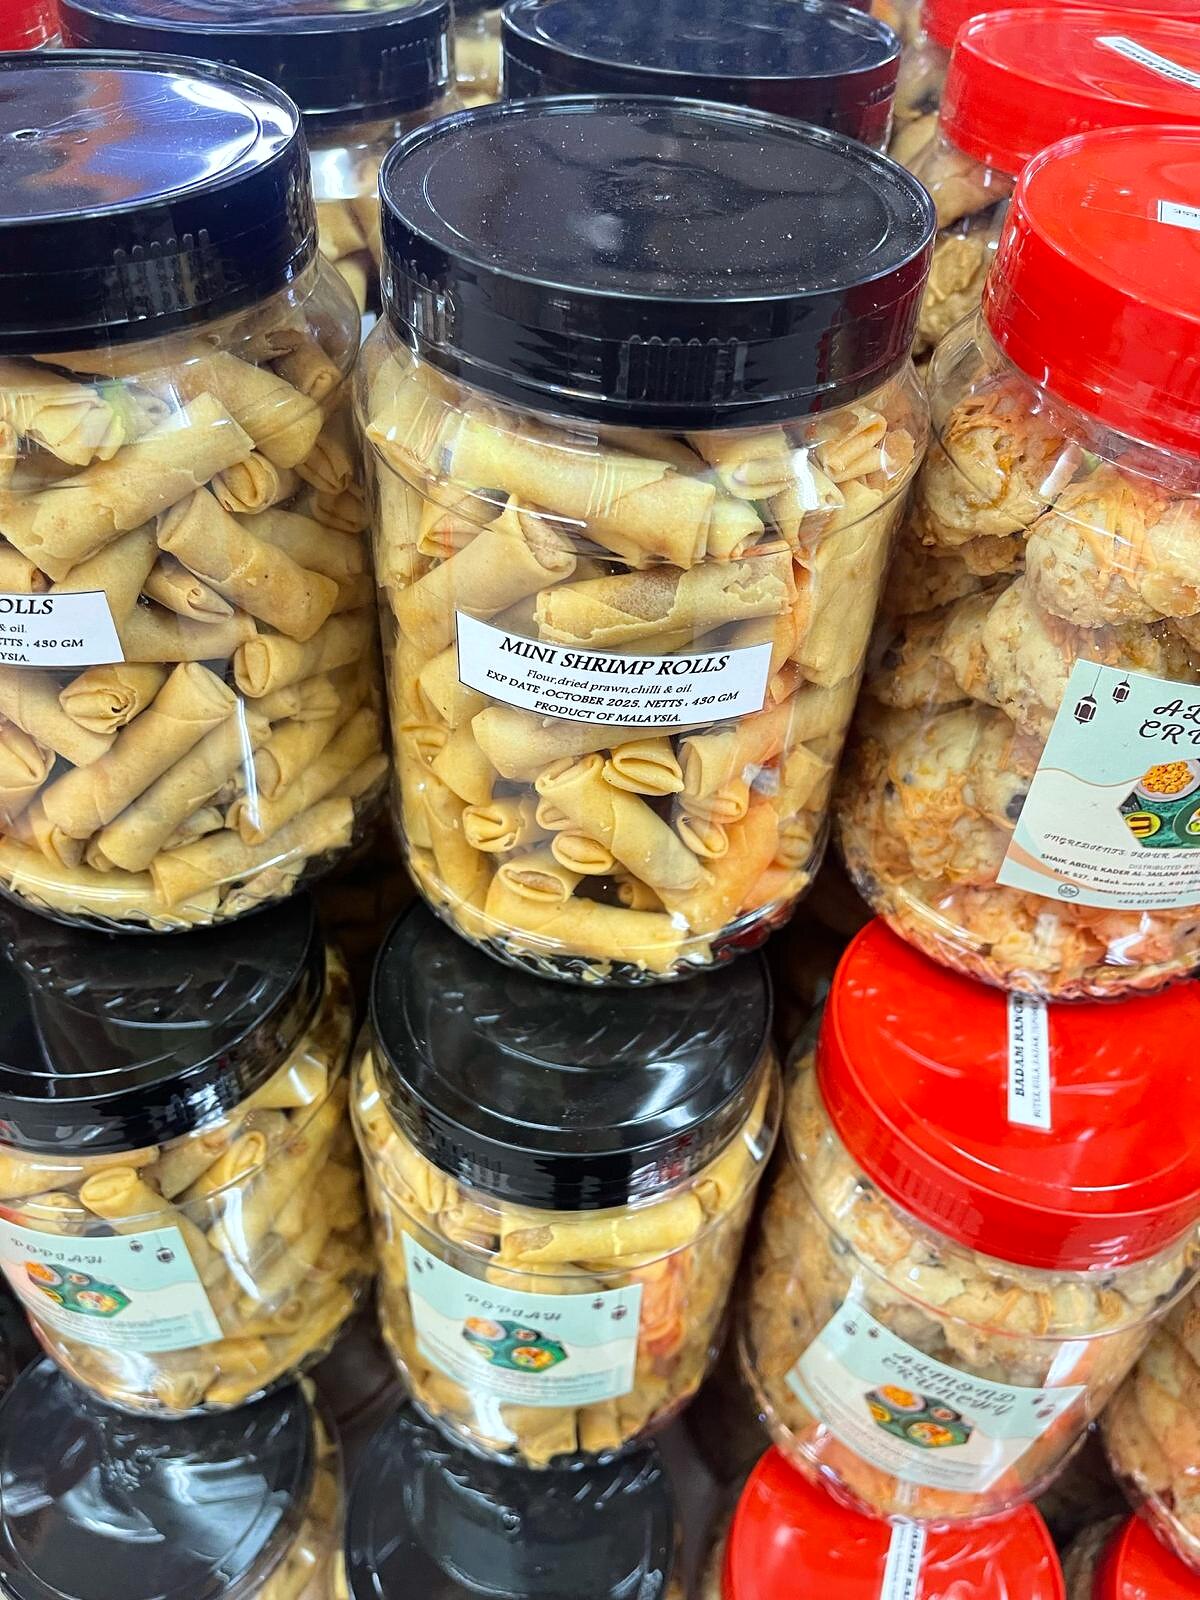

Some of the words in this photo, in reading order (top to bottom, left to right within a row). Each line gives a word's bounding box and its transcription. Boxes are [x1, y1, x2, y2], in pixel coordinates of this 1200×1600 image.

[33, 639, 58, 648] 430
[60, 639, 84, 648] GM
[499, 636, 559, 665] MINI
[560, 652, 655, 676] SHRIMP
[656, 655, 731, 676] ROLLS
[486, 669, 508, 683] EXP
[508, 677, 541, 694] DATE
[606, 698, 641, 708] 2025.
[645, 699, 684, 709] NETTS
[692, 696, 716, 706] 430
[717, 691, 739, 703] GM
[663, 685, 673, 694] &
[675, 683, 692, 693] oil.
[534, 700, 596, 719] PRODUCT
[596, 712, 616, 721] OF
[615, 713, 681, 723] MALAYSIA.
[1040, 853, 1068, 864] SHAIK
[1069, 860, 1098, 871] ABDUL
[1100, 867, 1130, 876] KADER
[1014, 1046, 1025, 1097] BADAM
